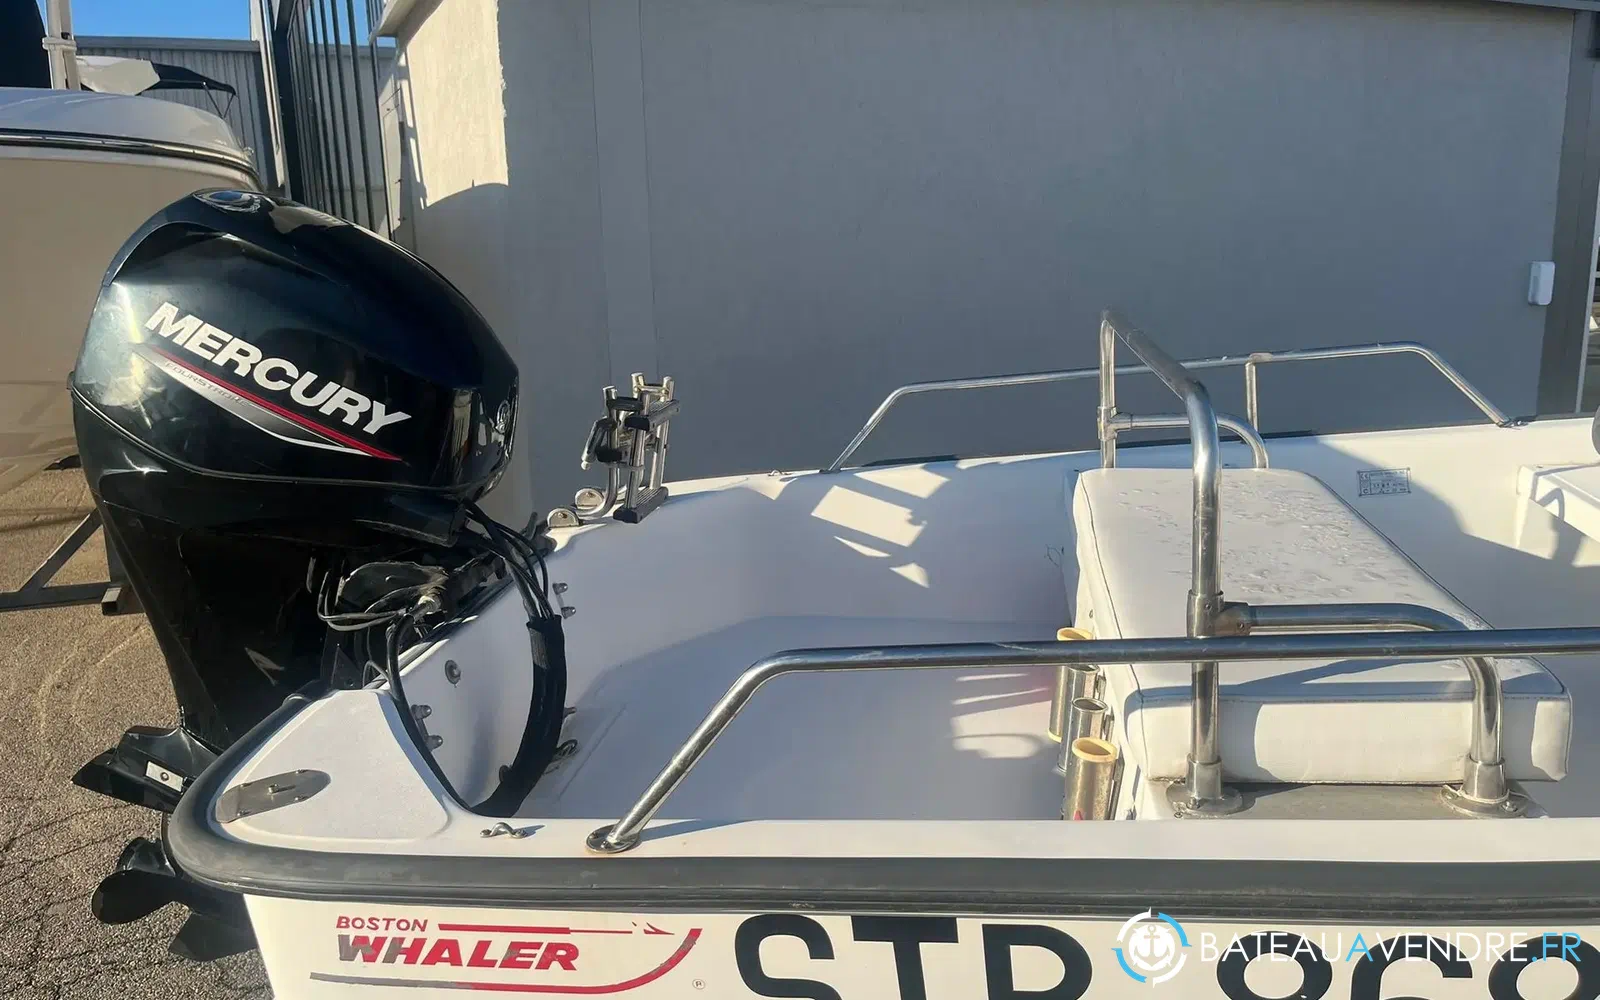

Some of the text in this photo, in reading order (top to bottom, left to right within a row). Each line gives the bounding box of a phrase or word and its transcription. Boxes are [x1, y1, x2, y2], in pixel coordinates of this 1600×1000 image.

[145, 301, 412, 434] MERCURY
[336, 916, 428, 932] BOSTON
[337, 934, 579, 970] WHALER
